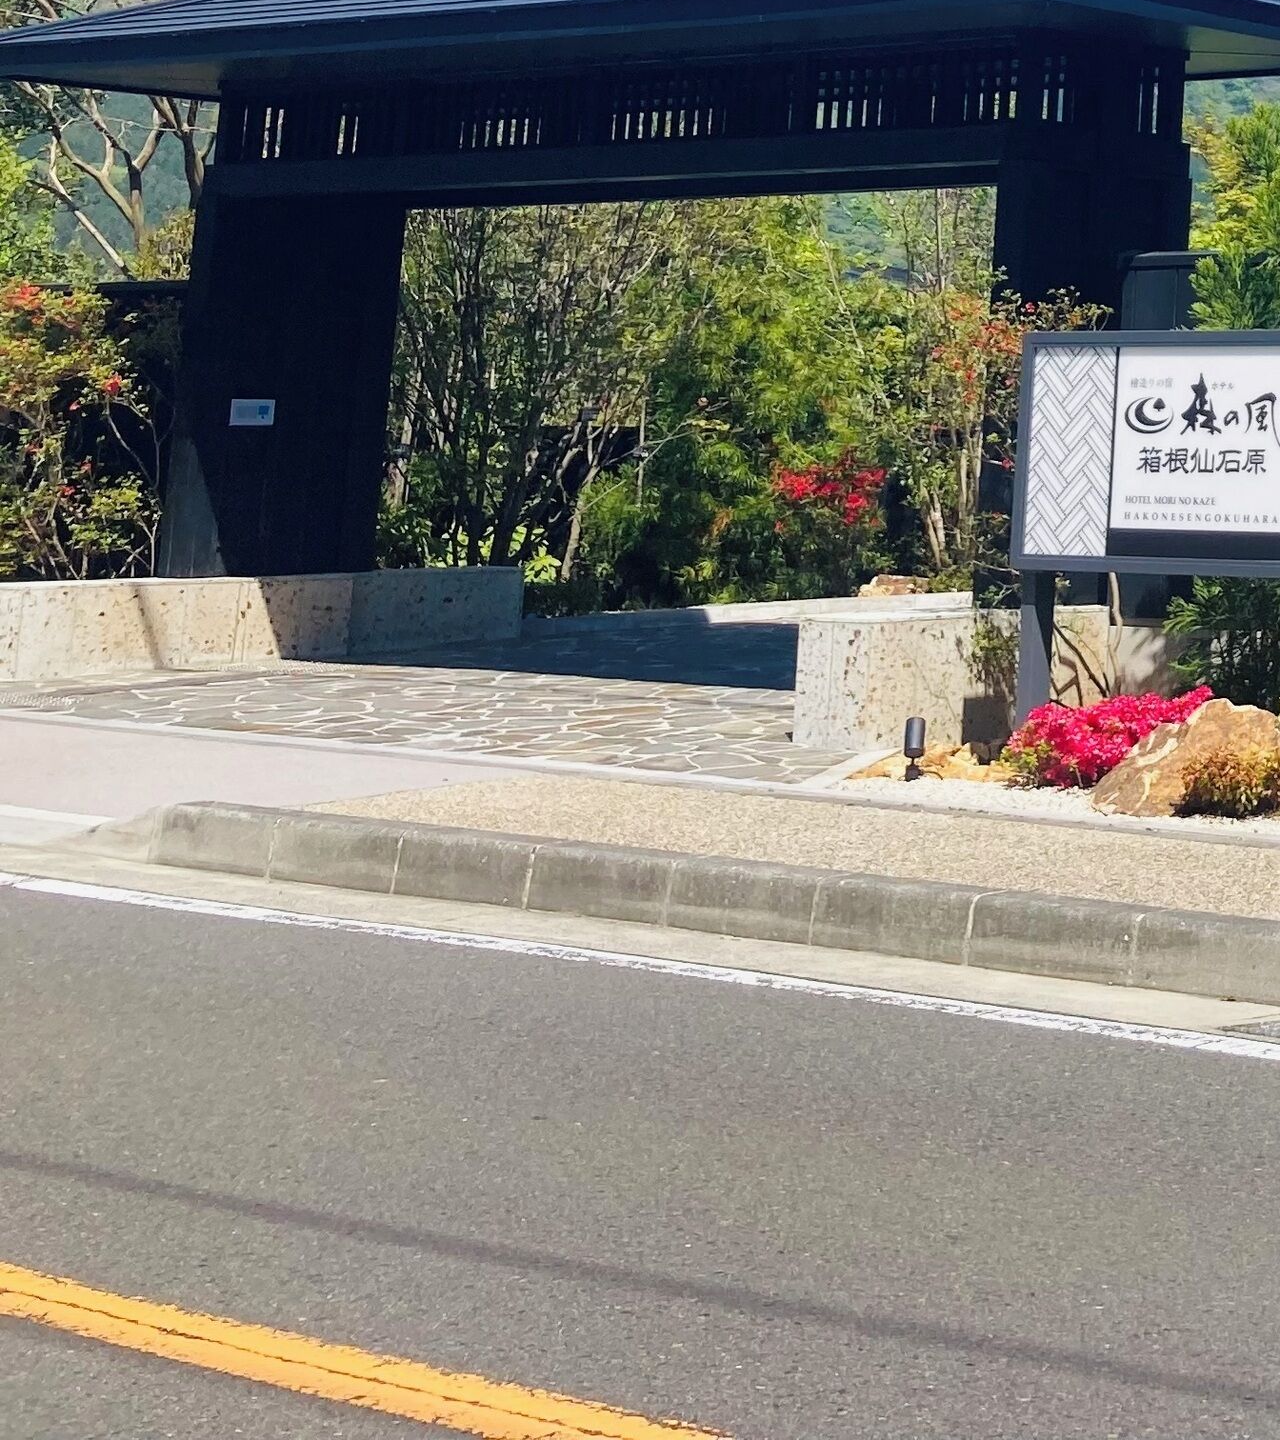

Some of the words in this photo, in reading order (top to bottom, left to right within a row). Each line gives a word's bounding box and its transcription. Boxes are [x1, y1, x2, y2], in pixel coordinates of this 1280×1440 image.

[1211, 381, 1235, 390] ホテル
[1136, 446, 1267, 475] 箱根仙石原
[1125, 495, 1151, 505] HOTEL
[1154, 496, 1176, 505] MORI
[1178, 497, 1192, 505] NO
[1193, 497, 1216, 506] KAZE
[1124, 511, 1279, 524] HAKONESENGOKUHARA
